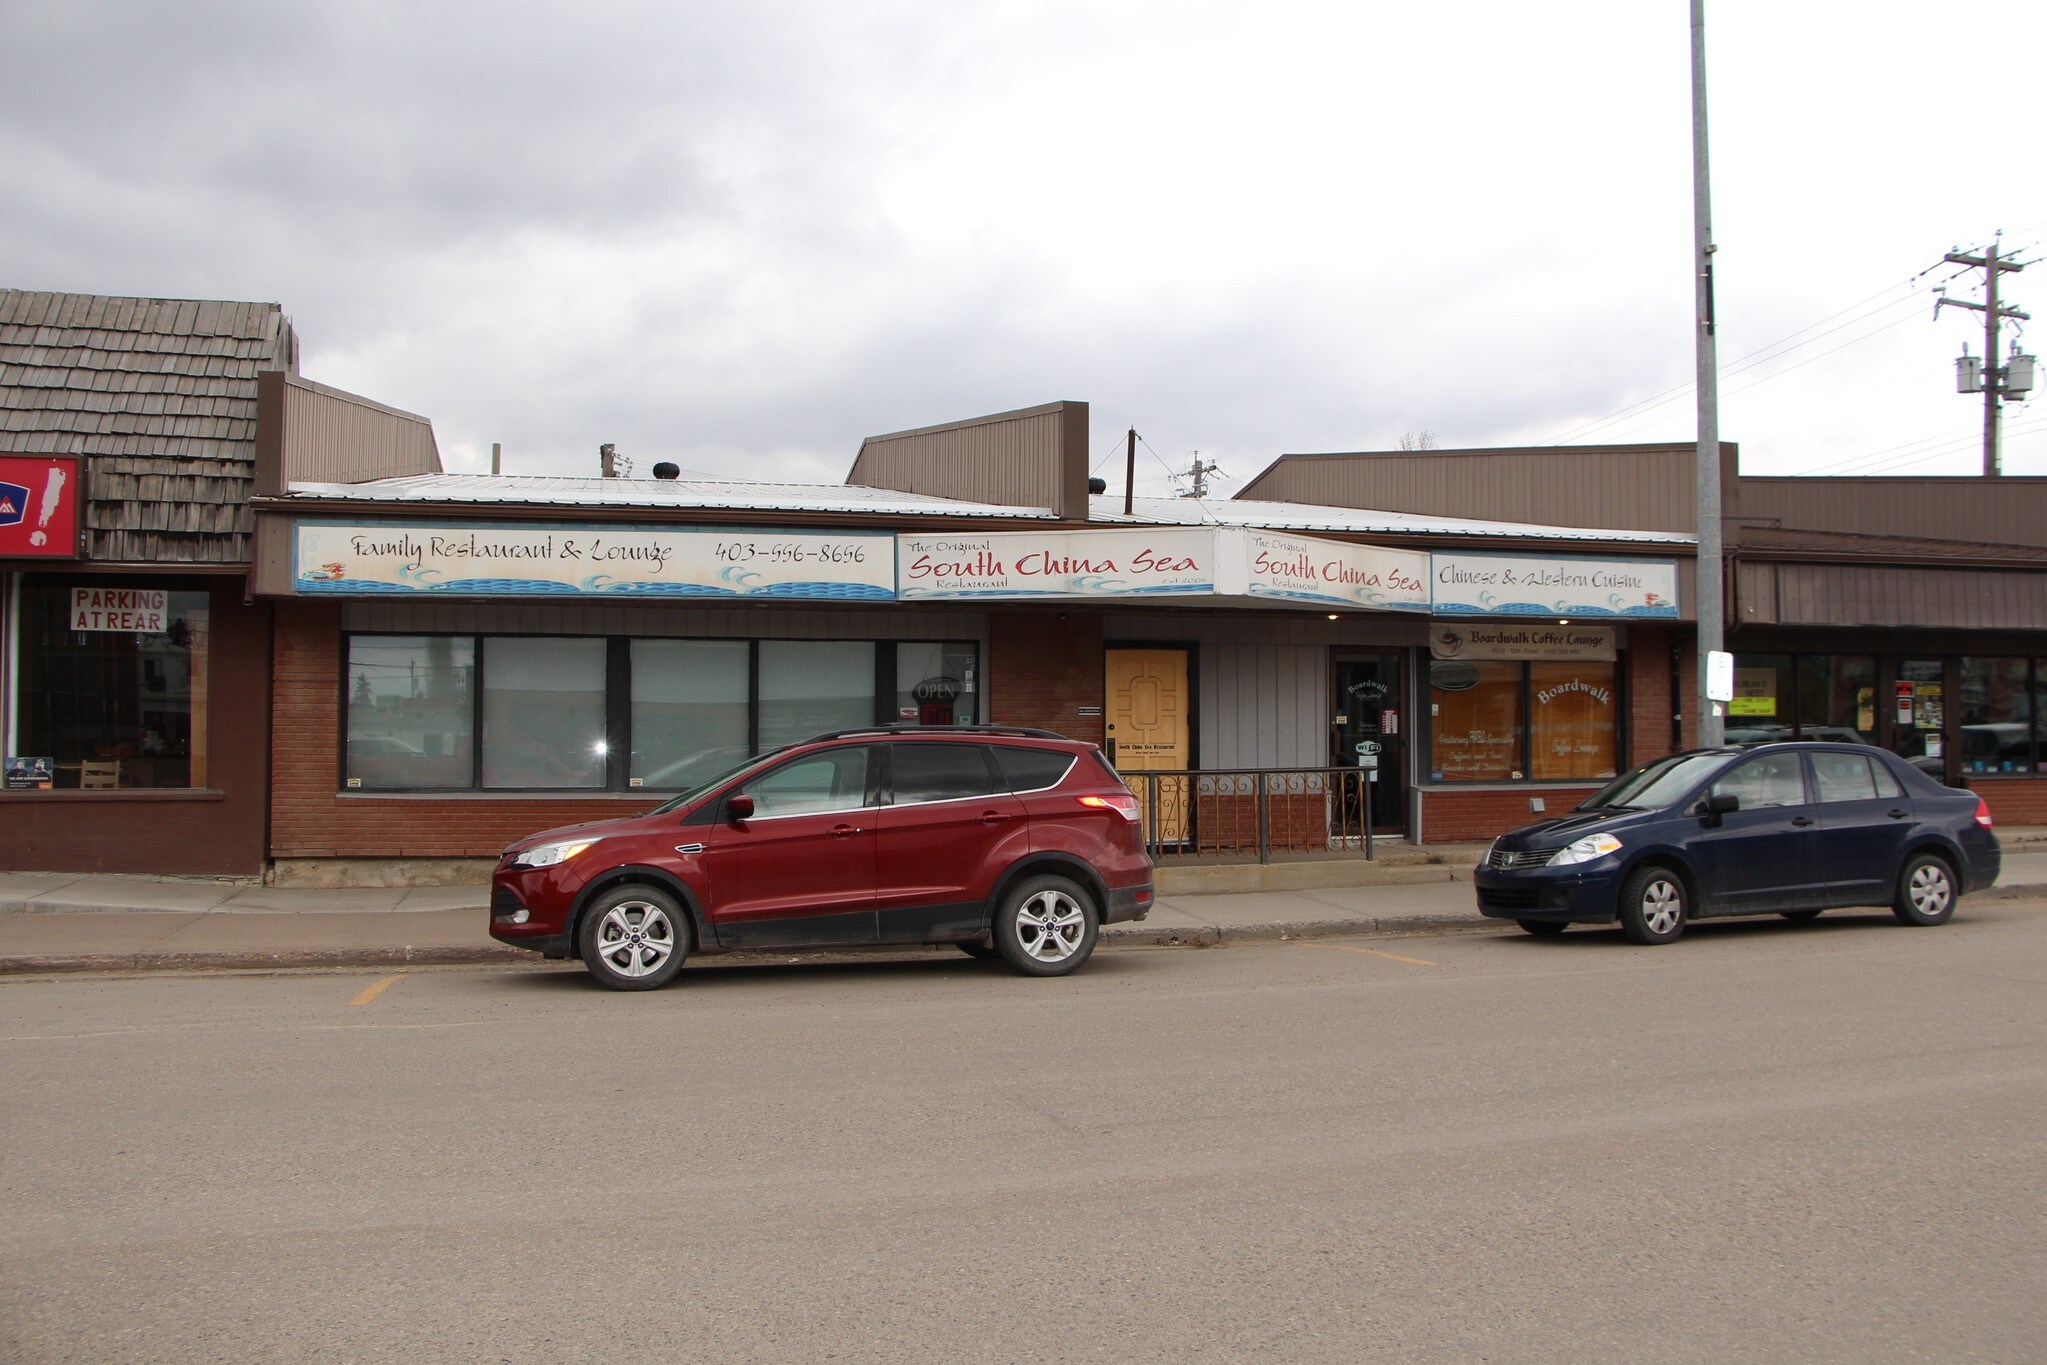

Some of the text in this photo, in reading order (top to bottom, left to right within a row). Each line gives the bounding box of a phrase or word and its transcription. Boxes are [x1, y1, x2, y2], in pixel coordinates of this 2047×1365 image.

[351, 533, 673, 573] Family Restaurant & Lounge
[715, 542, 865, 563] 403-556-8656
[906, 540, 990, 556] The Original
[1252, 537, 1307, 556] The Original
[908, 548, 1199, 579] South China Sea
[1253, 550, 1423, 592] South China Sea
[936, 576, 1008, 588] Restaurant
[1272, 577, 1319, 591] Restaurant
[1439, 564, 1642, 589] Chinese & Western Cuisine
[76, 590, 164, 610] PARKING
[76, 611, 160, 630] AT REAR
[1469, 630, 1604, 649] Boardwalk Coffee Lounge
[918, 683, 955, 699] OPEN
[1348, 679, 1388, 694] Boardwalk
[1537, 678, 1610, 705] Boardwalk
